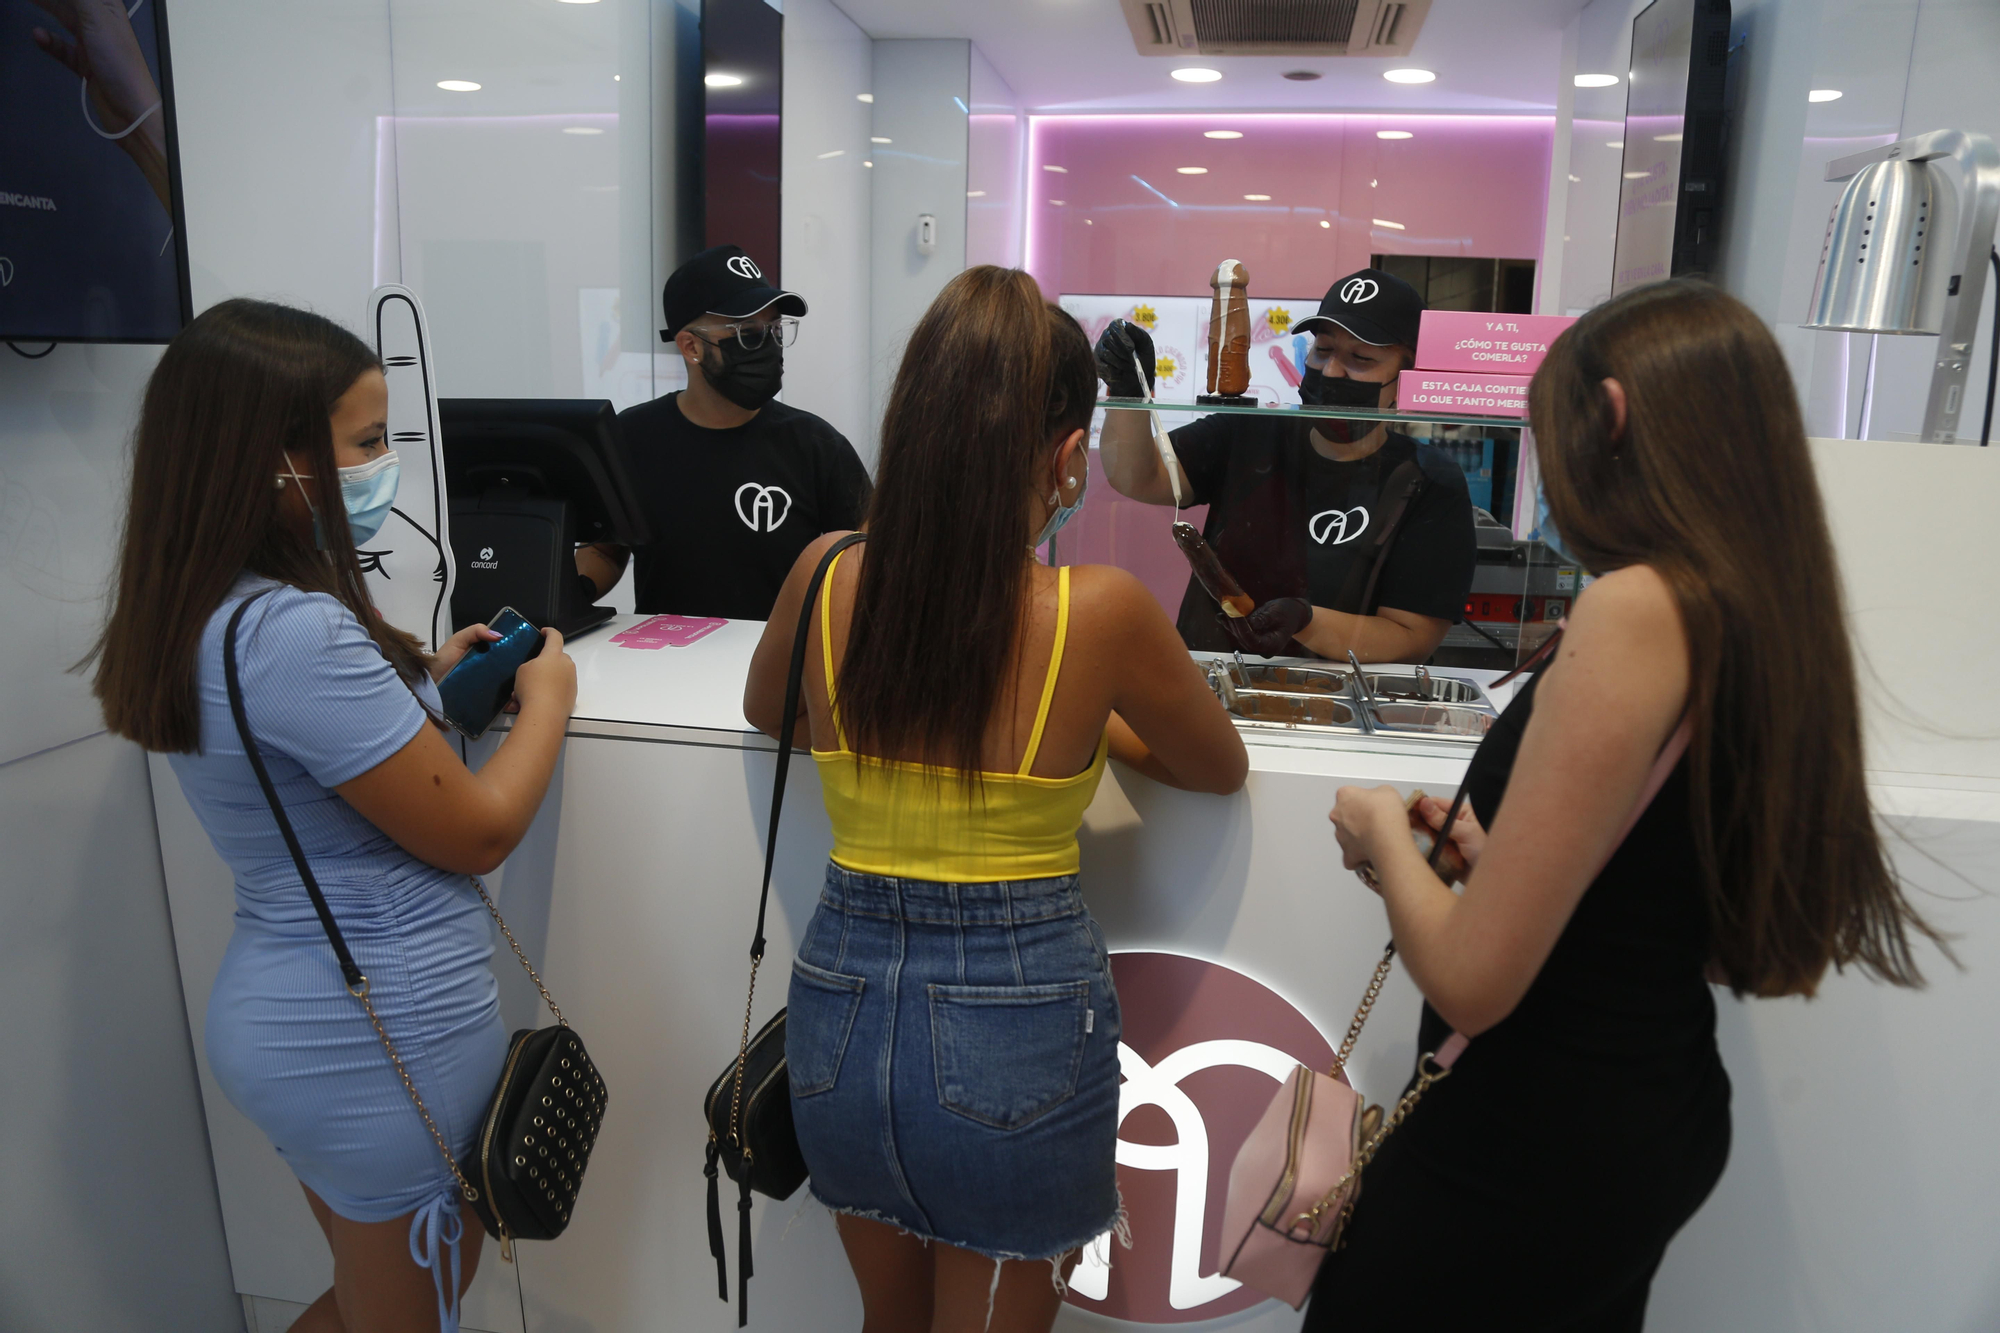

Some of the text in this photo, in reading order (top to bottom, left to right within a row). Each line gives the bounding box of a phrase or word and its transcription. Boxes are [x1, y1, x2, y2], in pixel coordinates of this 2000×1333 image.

[0, 191, 58, 212] ENCANTA
[1486, 322, 1494, 331] Y
[1506, 323, 1519, 333] TI,
[1455, 338, 1547, 352] ¿CÓMO TE GUSTA
[1472, 352, 1528, 363] COMERLA?
[1422, 382, 1450, 391] ESTA
[1453, 383, 1482, 392] CAJA
[1413, 395, 1528, 408] LO QUE TANTO MERE
[471, 560, 498, 569] concord
